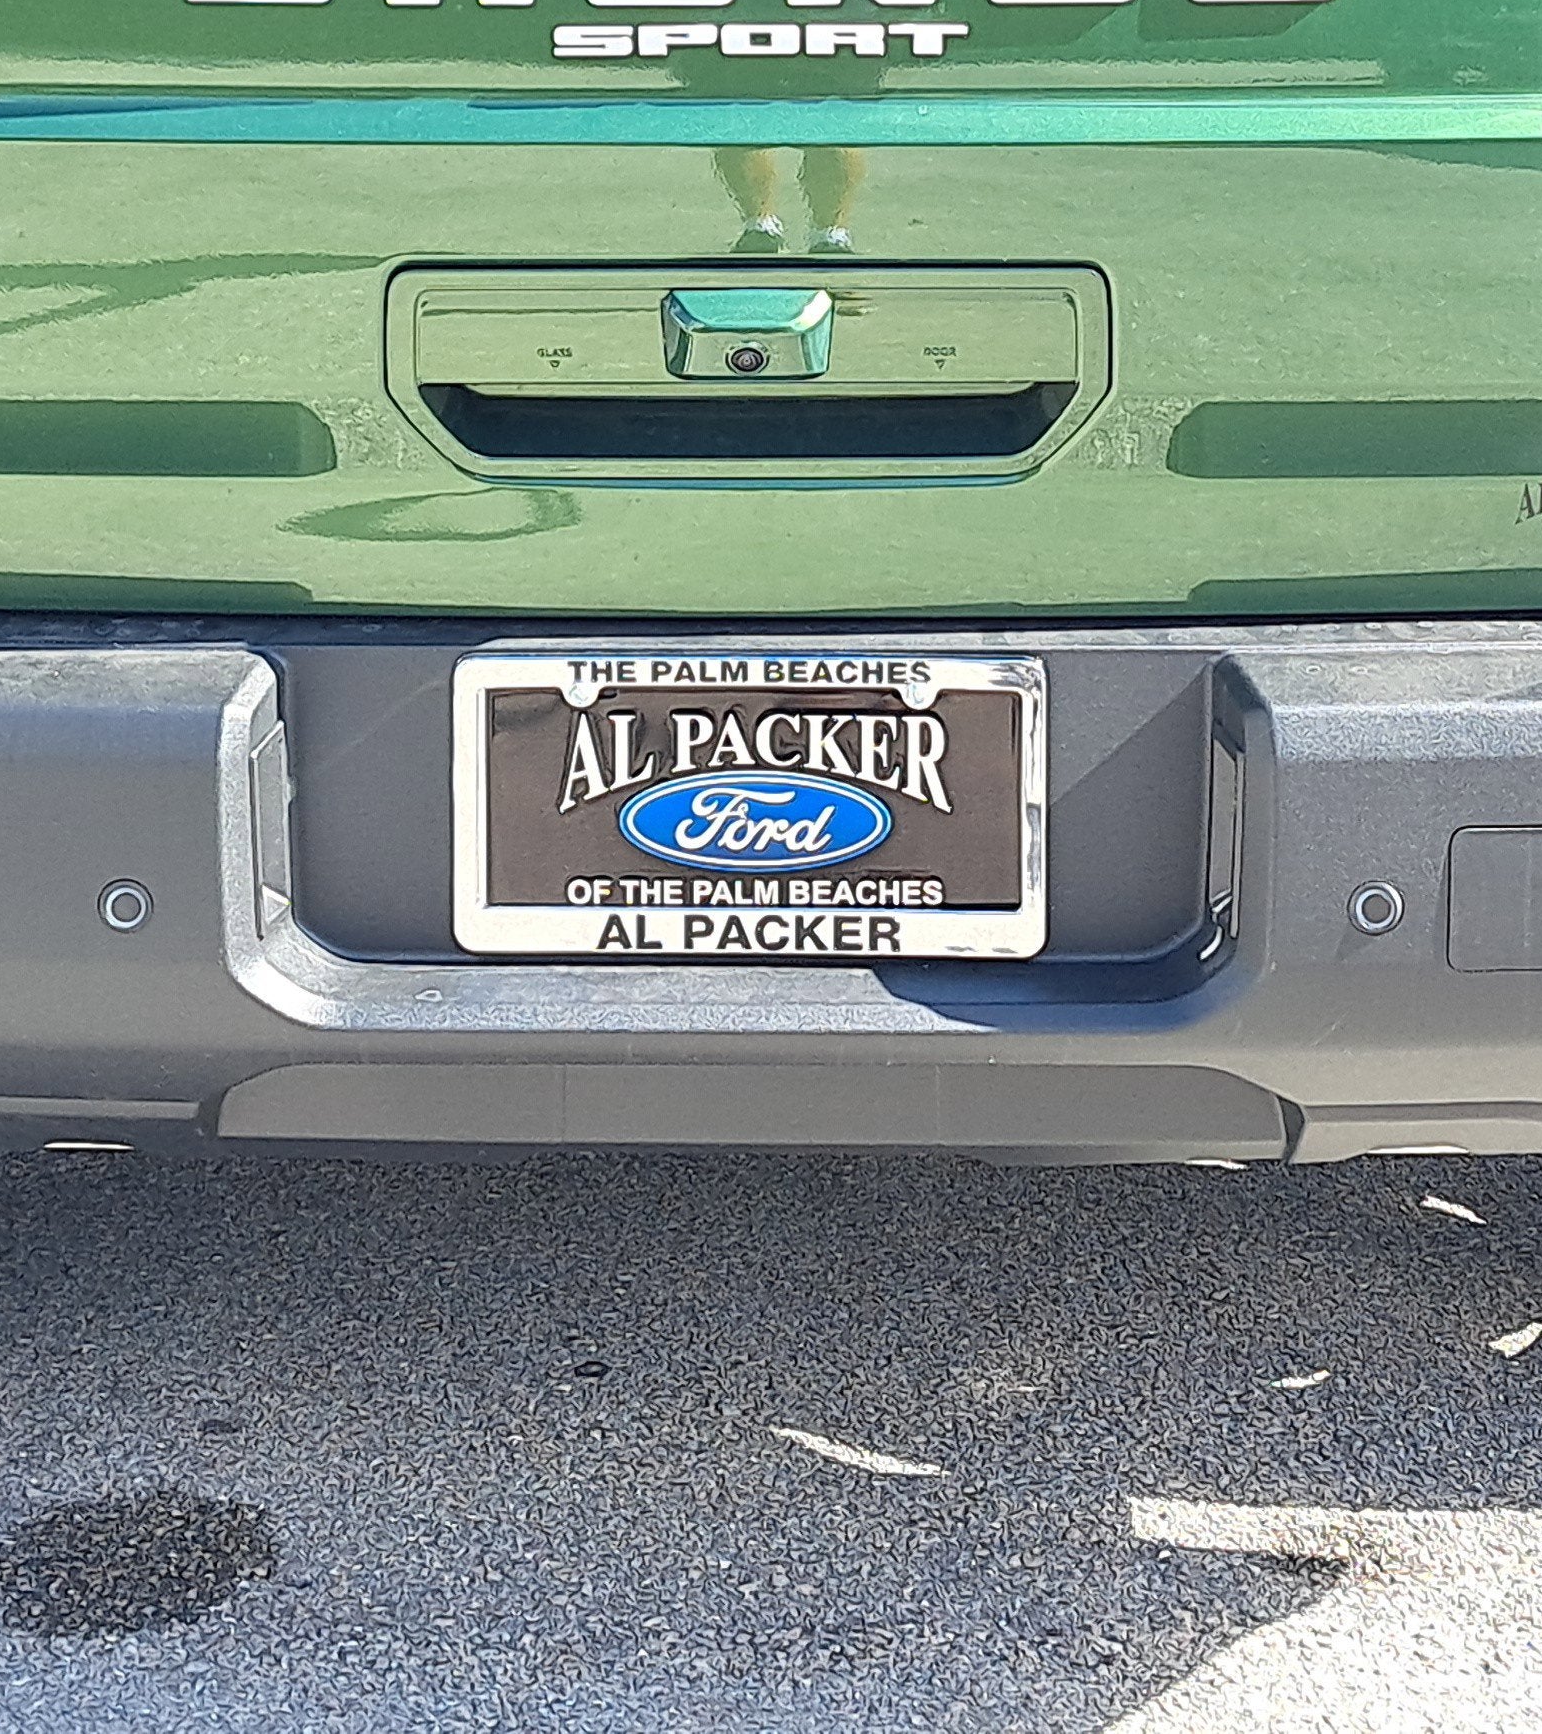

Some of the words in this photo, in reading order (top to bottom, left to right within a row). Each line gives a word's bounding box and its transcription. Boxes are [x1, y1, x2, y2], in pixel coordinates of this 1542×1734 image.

[552, 22, 970, 58] SPORT
[567, 660, 637, 685] THE
[650, 660, 749, 685] PALM
[762, 660, 932, 685] BEACHES
[559, 711, 656, 816] AL
[670, 712, 952, 816] PACKER
[673, 786, 836, 854] Ford
[566, 879, 612, 906] OF
[619, 879, 683, 906] THE
[691, 879, 780, 906] PALM
[789, 879, 944, 907] BEACHES
[596, 914, 662, 951] AL
[683, 914, 902, 953] PACKER
